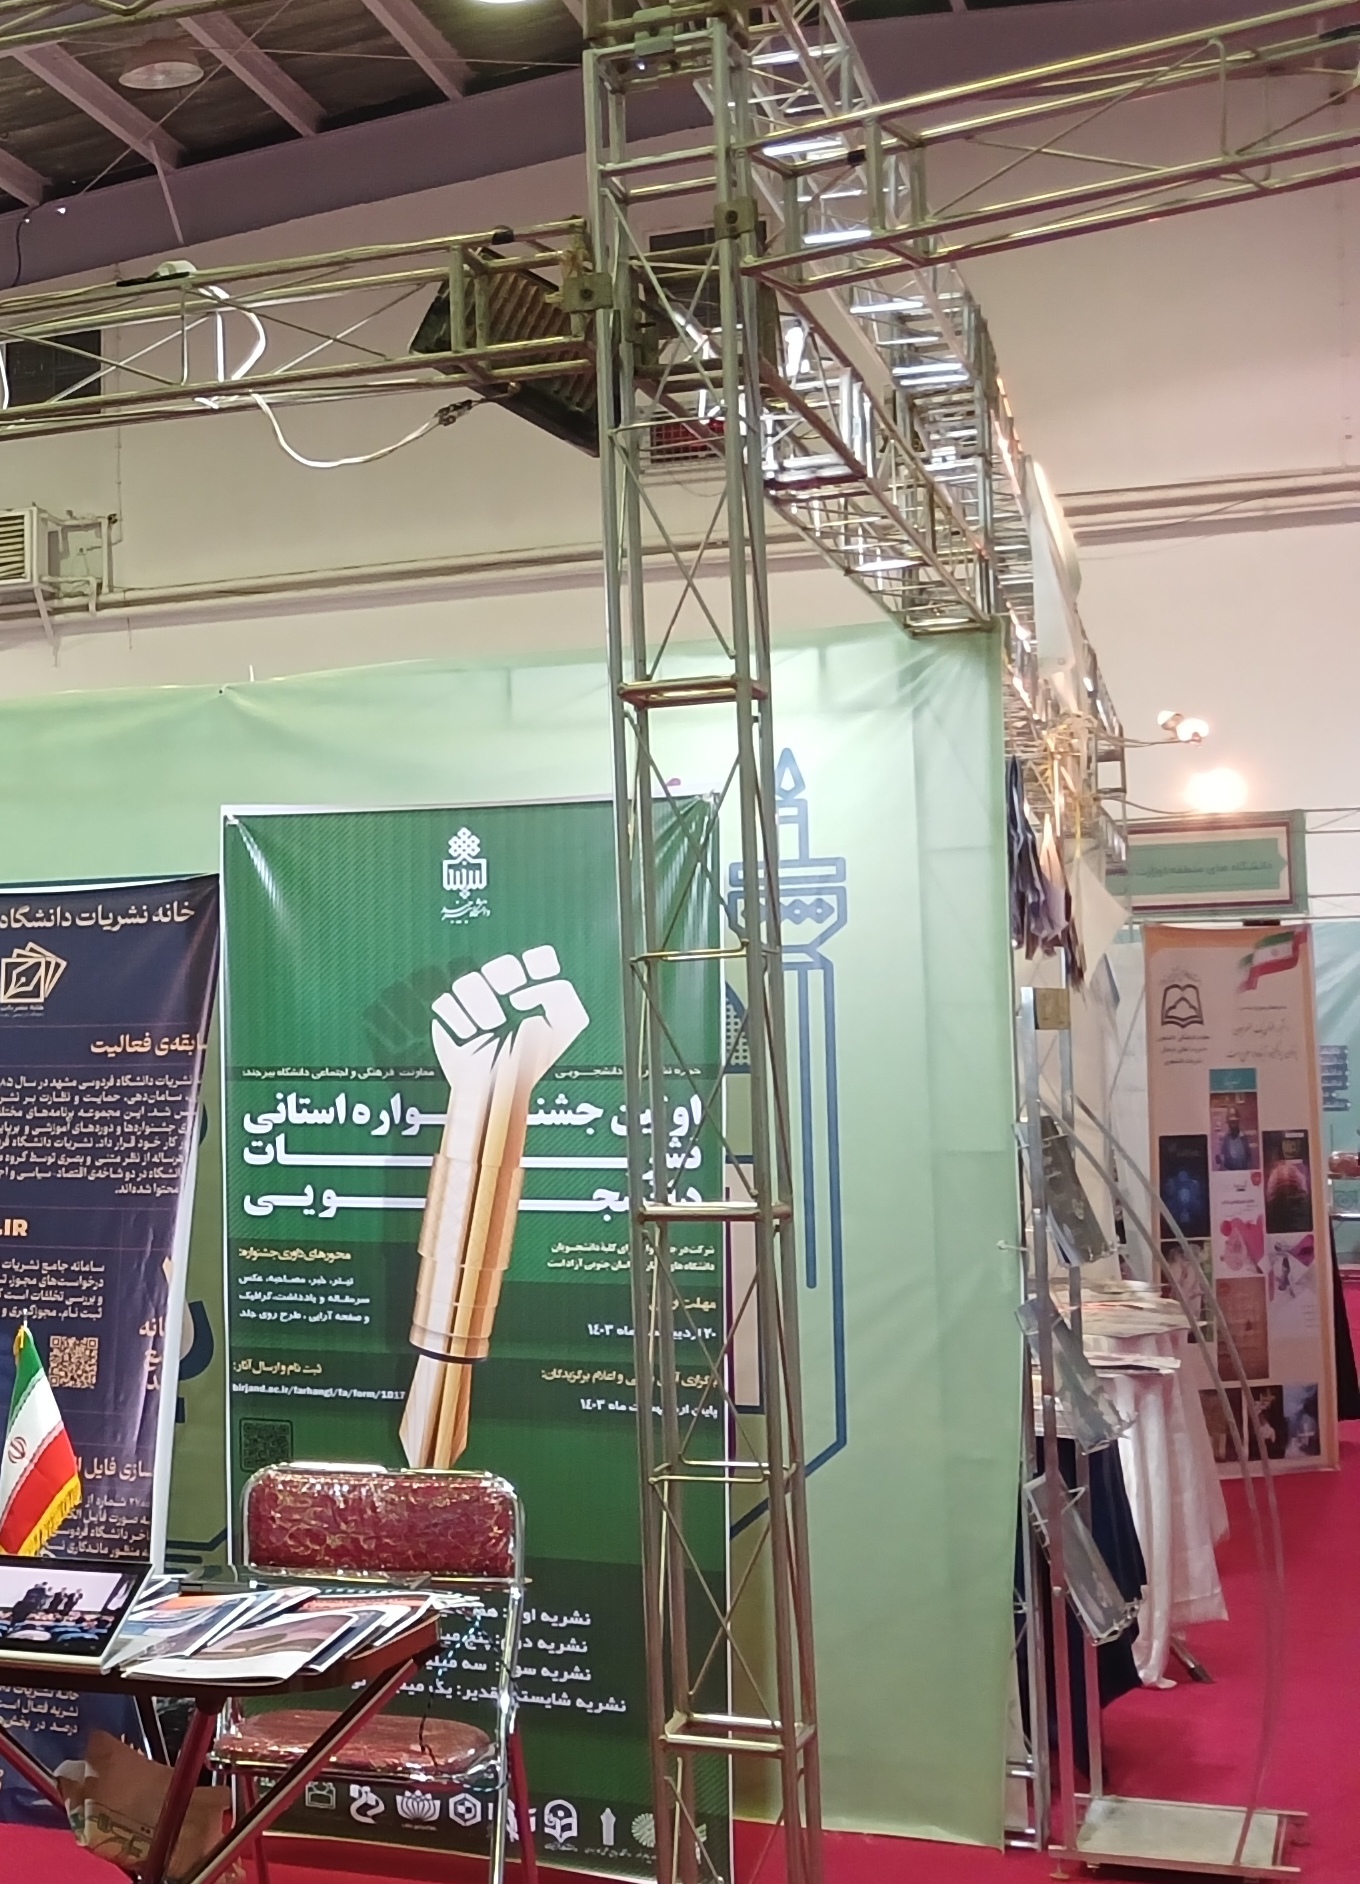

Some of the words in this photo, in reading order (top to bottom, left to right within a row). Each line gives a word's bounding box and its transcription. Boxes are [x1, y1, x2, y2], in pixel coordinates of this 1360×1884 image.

[0, 904, 71, 930] دانشگاه
[75, 904, 148, 932] نشریات
[153, 900, 195, 924] خانه
[91, 1031, 152, 1055] فعالیت
[277, 1067, 310, 1077] دانشگاه
[311, 1068, 349, 1079] اجتماعی
[357, 1067, 395, 1079] فرهنگی
[15, 1076, 36, 1089] سال
[49, 1076, 77, 1090] مشهد
[79, 1075, 114, 1090] فردوسی
[116, 1075, 153, 1087] دانشگاه
[39, 1090, 71, 1104] نظارت
[83, 1091, 121, 1104] حمایت
[78, 1107, 121, 1120] مجموعه
[243, 1092, 346, 1134] استانی
[12, 1136, 51, 1147] دانشگاه
[54, 1137, 93, 1150] نشریات
[114, 1136, 136, 1151] قرار
[138, 1136, 161, 1150] خود
[29, 1151, 56, 1165] توسط
[1, 1258, 39, 1272] نشریات
[41, 1260, 68, 1273] جامع
[70, 1260, 105, 1272] سامانه
[4, 1289, 29, 1300] است
[80, 1307, 102, 1321] ثبت
[84, 1456, 117, 1479] فایل
[541, 1610, 591, 1628] نشریه
[537, 1637, 588, 1654] نشریه
[462, 1658, 487, 1671] سه
[541, 1665, 592, 1682] نشریه
[575, 1697, 627, 1714] نشریه
